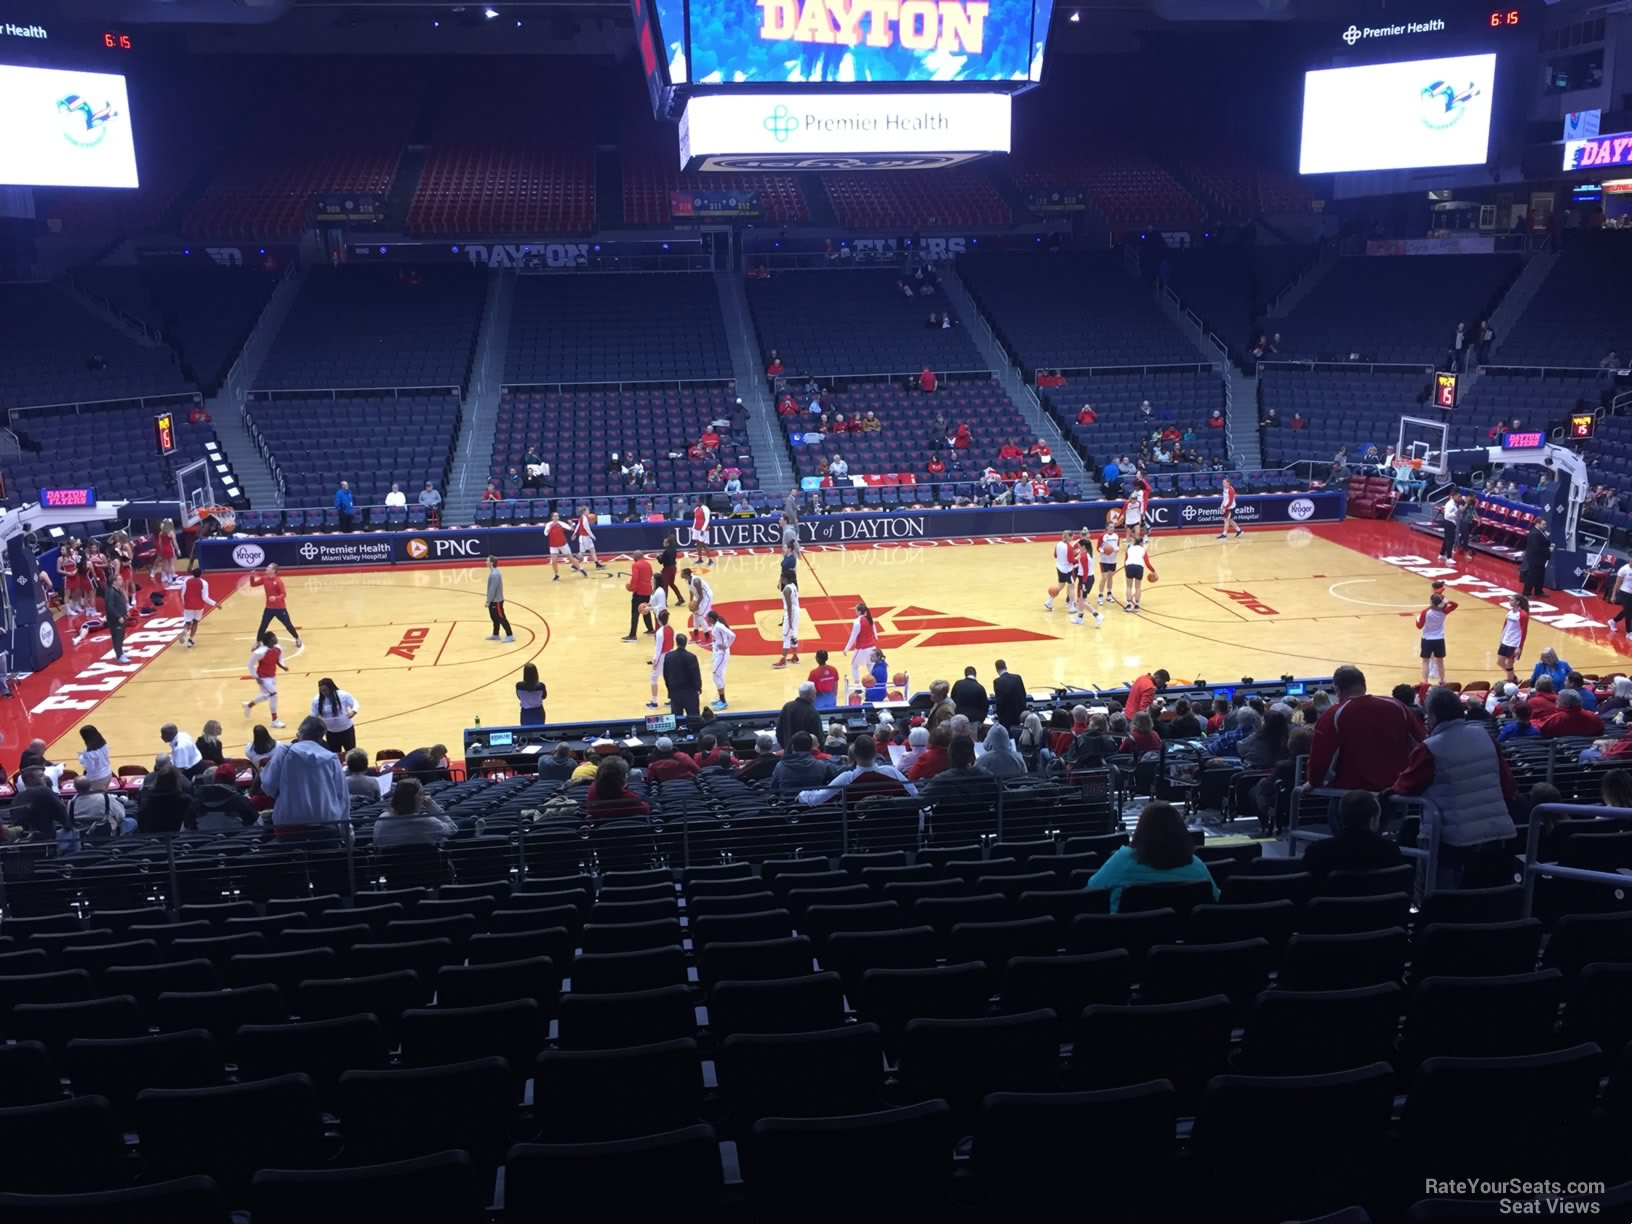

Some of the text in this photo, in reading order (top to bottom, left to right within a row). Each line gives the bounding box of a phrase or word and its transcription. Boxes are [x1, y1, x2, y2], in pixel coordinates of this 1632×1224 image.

[757, 0, 989, 54] DAYTON
[1490, 11, 1519, 27] 6:15
[6, 24, 48, 40] Health
[1363, 18, 1446, 40] Premier Health
[104, 33, 132, 50] 6:15
[804, 112, 950, 132] Premier Health
[464, 243, 589, 269] DAYTON
[46, 489, 88, 499] DAYTON
[1234, 505, 1255, 515] ealth
[1237, 513, 1260, 521] Hospital
[1290, 504, 1313, 517] Kroger
[822, 524, 835, 538] of
[840, 517, 925, 540] DAYTON
[320, 542, 392, 555] Premier Health
[433, 538, 481, 556] PNC
[872, 536, 1038, 550] COURT
[236, 550, 262, 564] Kroger
[321, 552, 388, 562] Miami Valley Hospital
[1379, 554, 1608, 629] DAYTON
[29, 616, 186, 715] FLYERS
